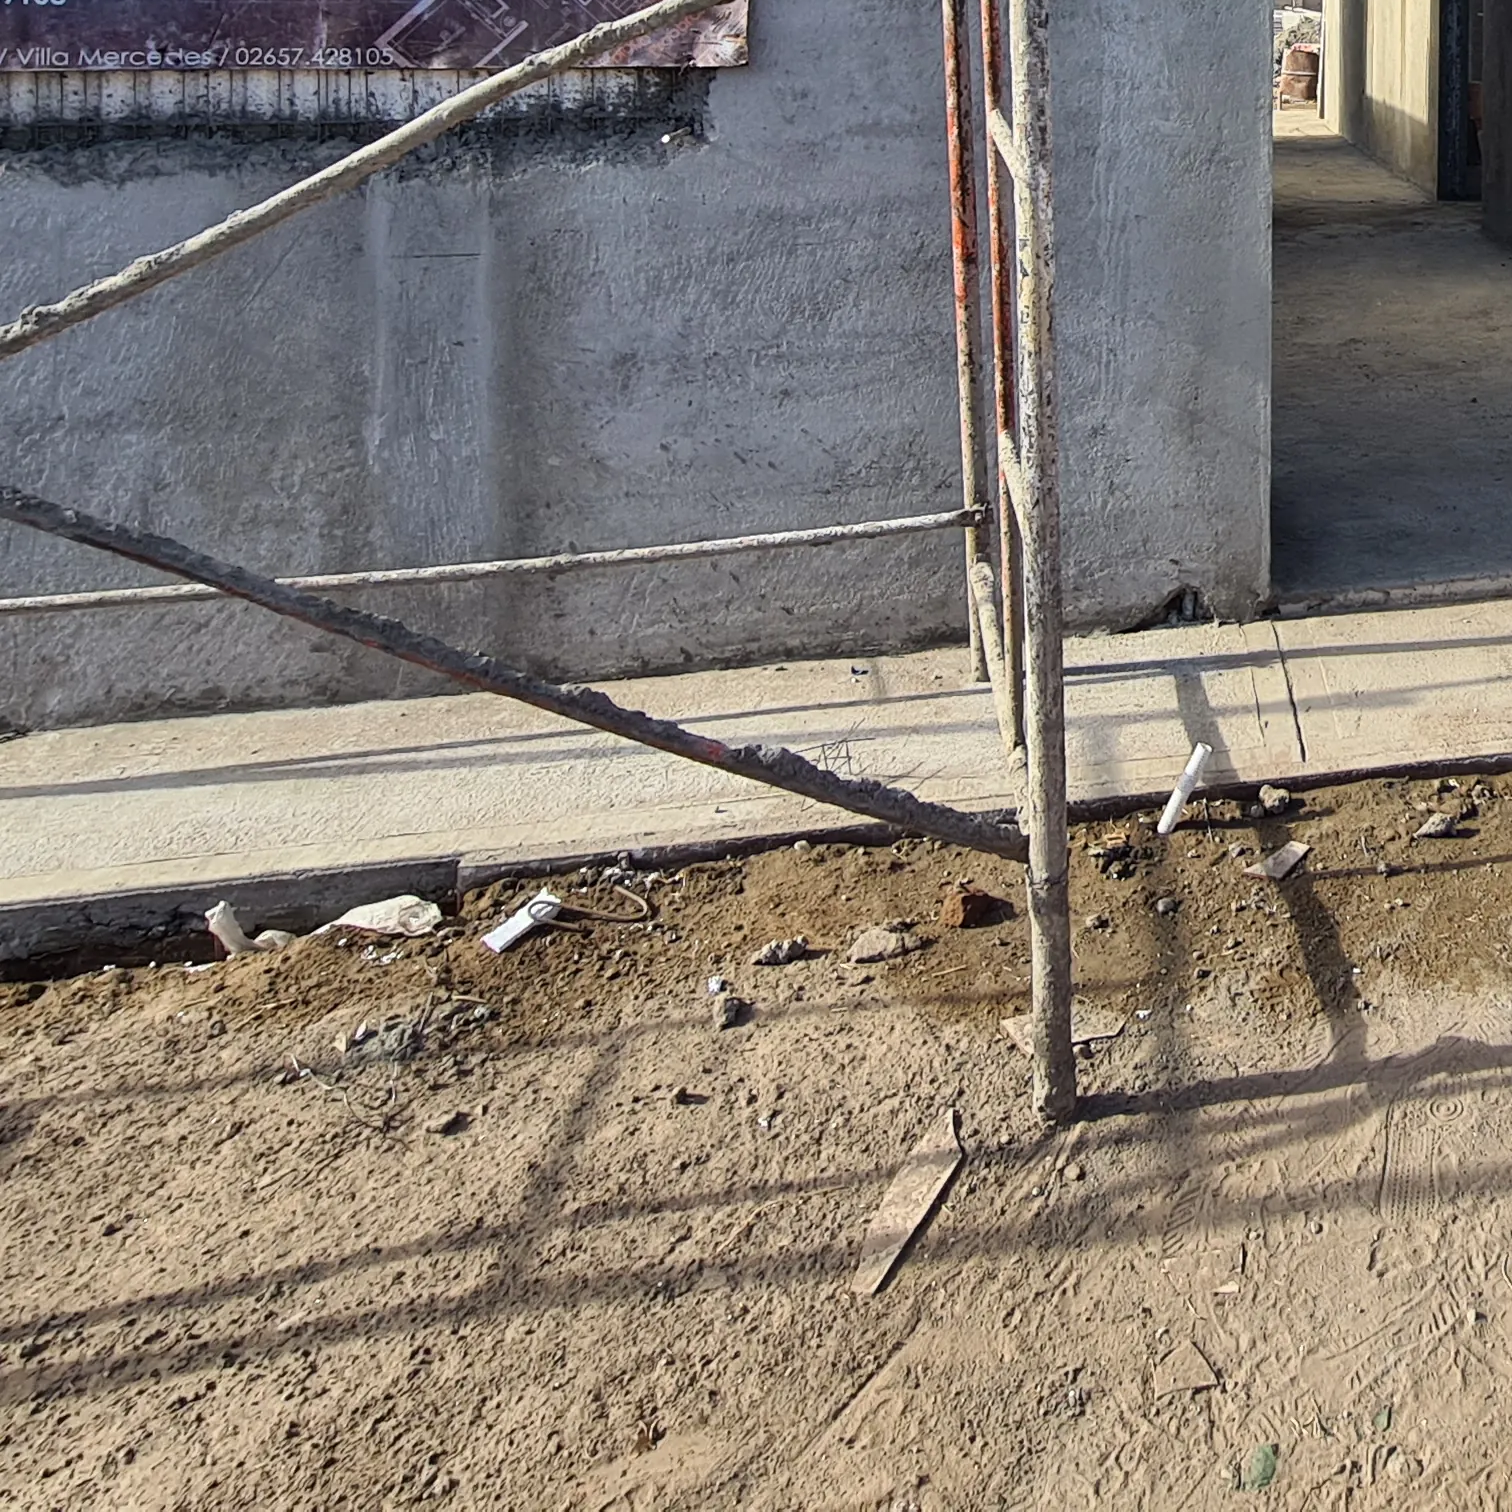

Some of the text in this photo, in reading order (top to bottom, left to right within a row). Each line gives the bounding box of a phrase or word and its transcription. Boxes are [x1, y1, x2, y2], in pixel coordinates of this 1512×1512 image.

[15, 47, 70, 66] Villa
[77, 47, 213, 67] Mercedes
[234, 46, 395, 67] 02657.428105
